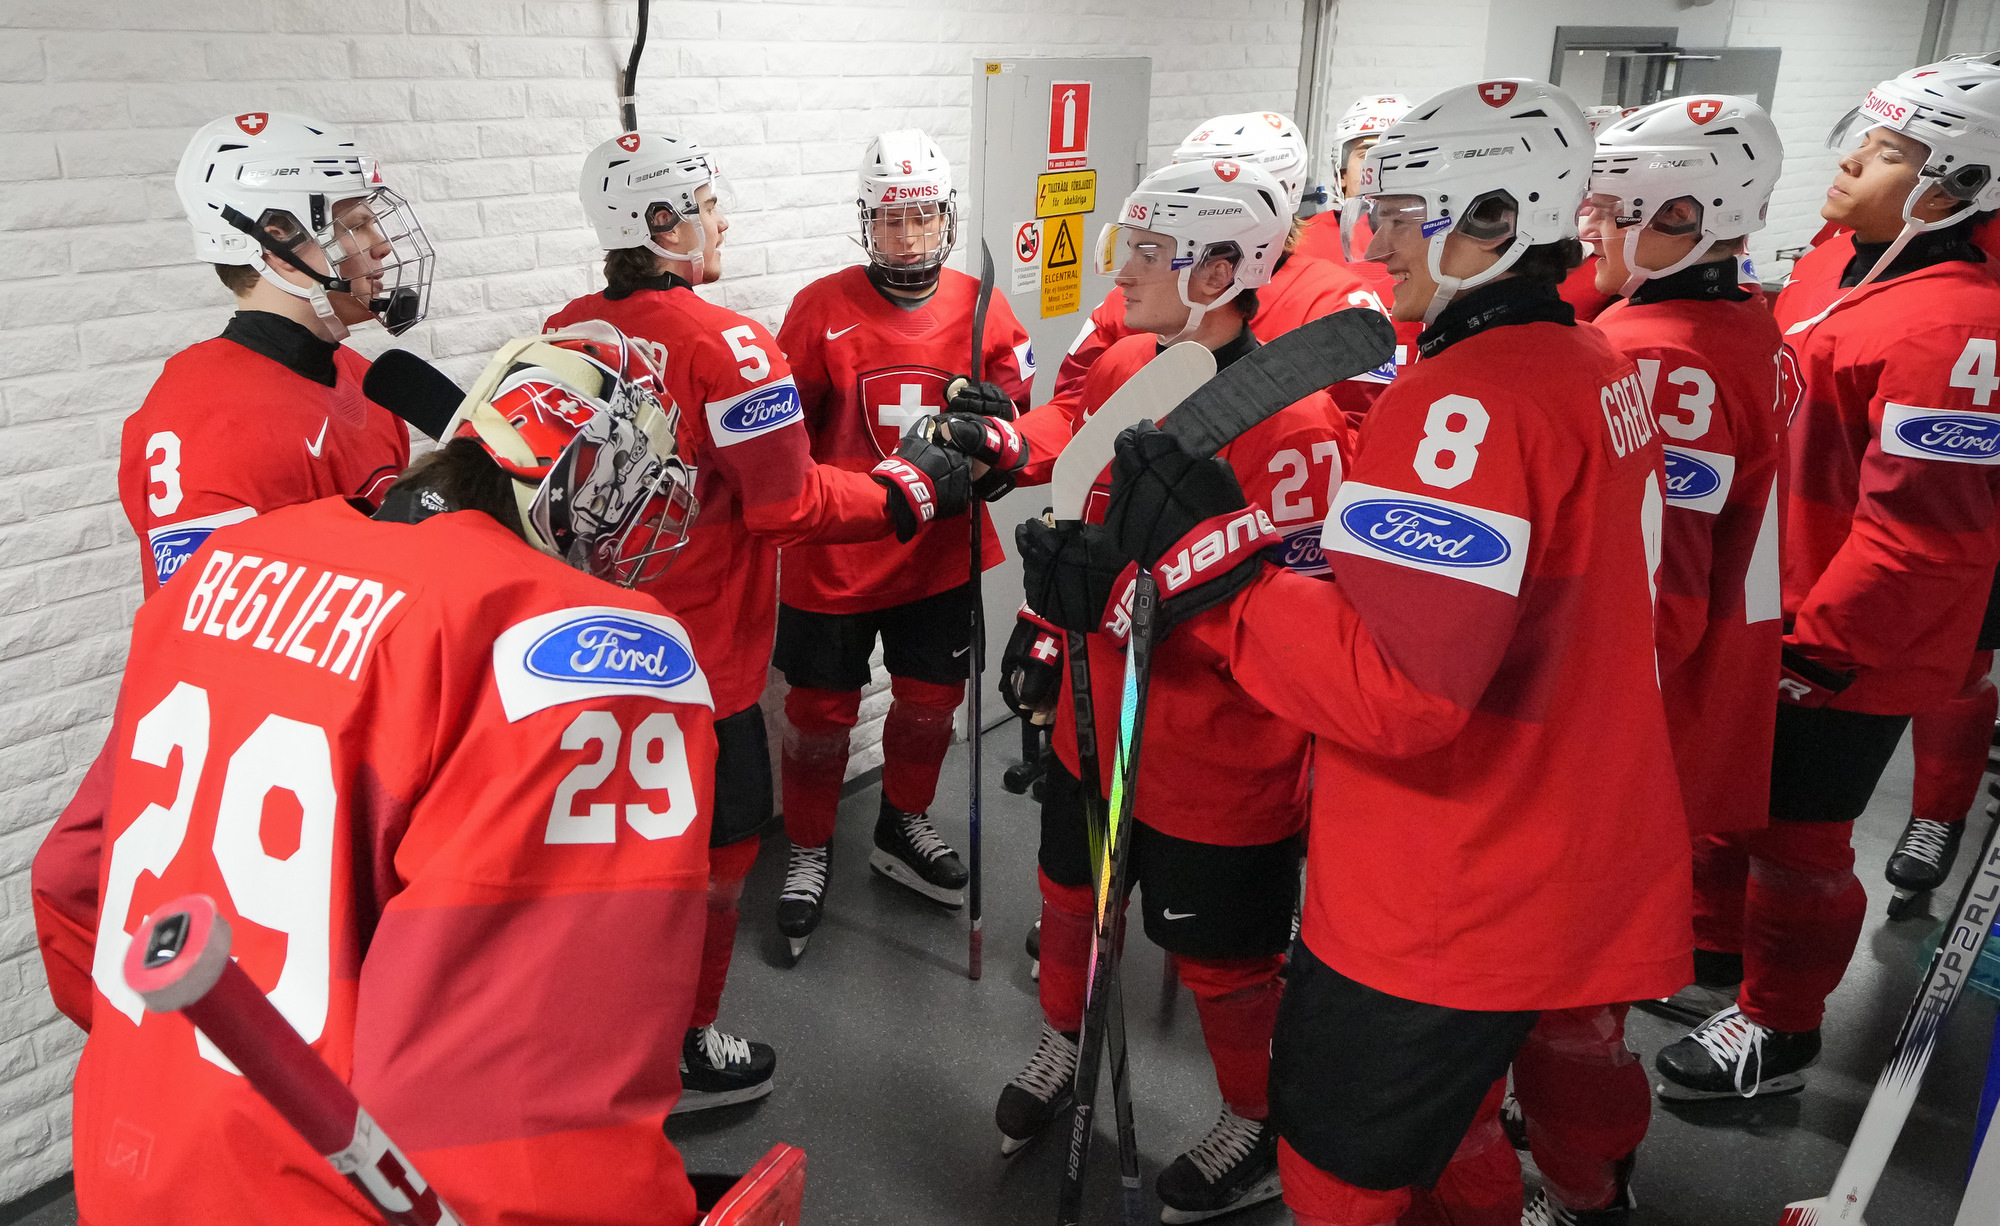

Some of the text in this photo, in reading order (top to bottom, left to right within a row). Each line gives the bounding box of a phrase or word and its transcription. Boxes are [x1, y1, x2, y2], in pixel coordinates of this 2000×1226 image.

[1865, 96, 1906, 121] SWISS
[635, 168, 670, 183] BAUER
[1451, 147, 1515, 160] BAUER
[1648, 159, 1705, 169] BAUER
[899, 184, 939, 199] SWISS
[1198, 208, 1243, 216] BAUER
[1045, 270, 1078, 284] ELCENTRAL
[721, 325, 771, 383] 5
[1949, 338, 2000, 406] 4
[742, 392, 796, 427] Ford
[1412, 393, 1491, 490] 8
[1921, 421, 2000, 452] Ford
[145, 430, 184, 518] 3
[1268, 440, 1343, 522] 27
[1285, 535, 1327, 565] For
[1370, 508, 1474, 559] Ford
[153, 537, 193, 577] For
[182, 550, 407, 681] BEGLIERI
[570, 626, 668, 677] Ford
[544, 710, 698, 844] 29
[91, 681, 338, 1077] 29
[1068, 1114, 1085, 1180] BAUER
